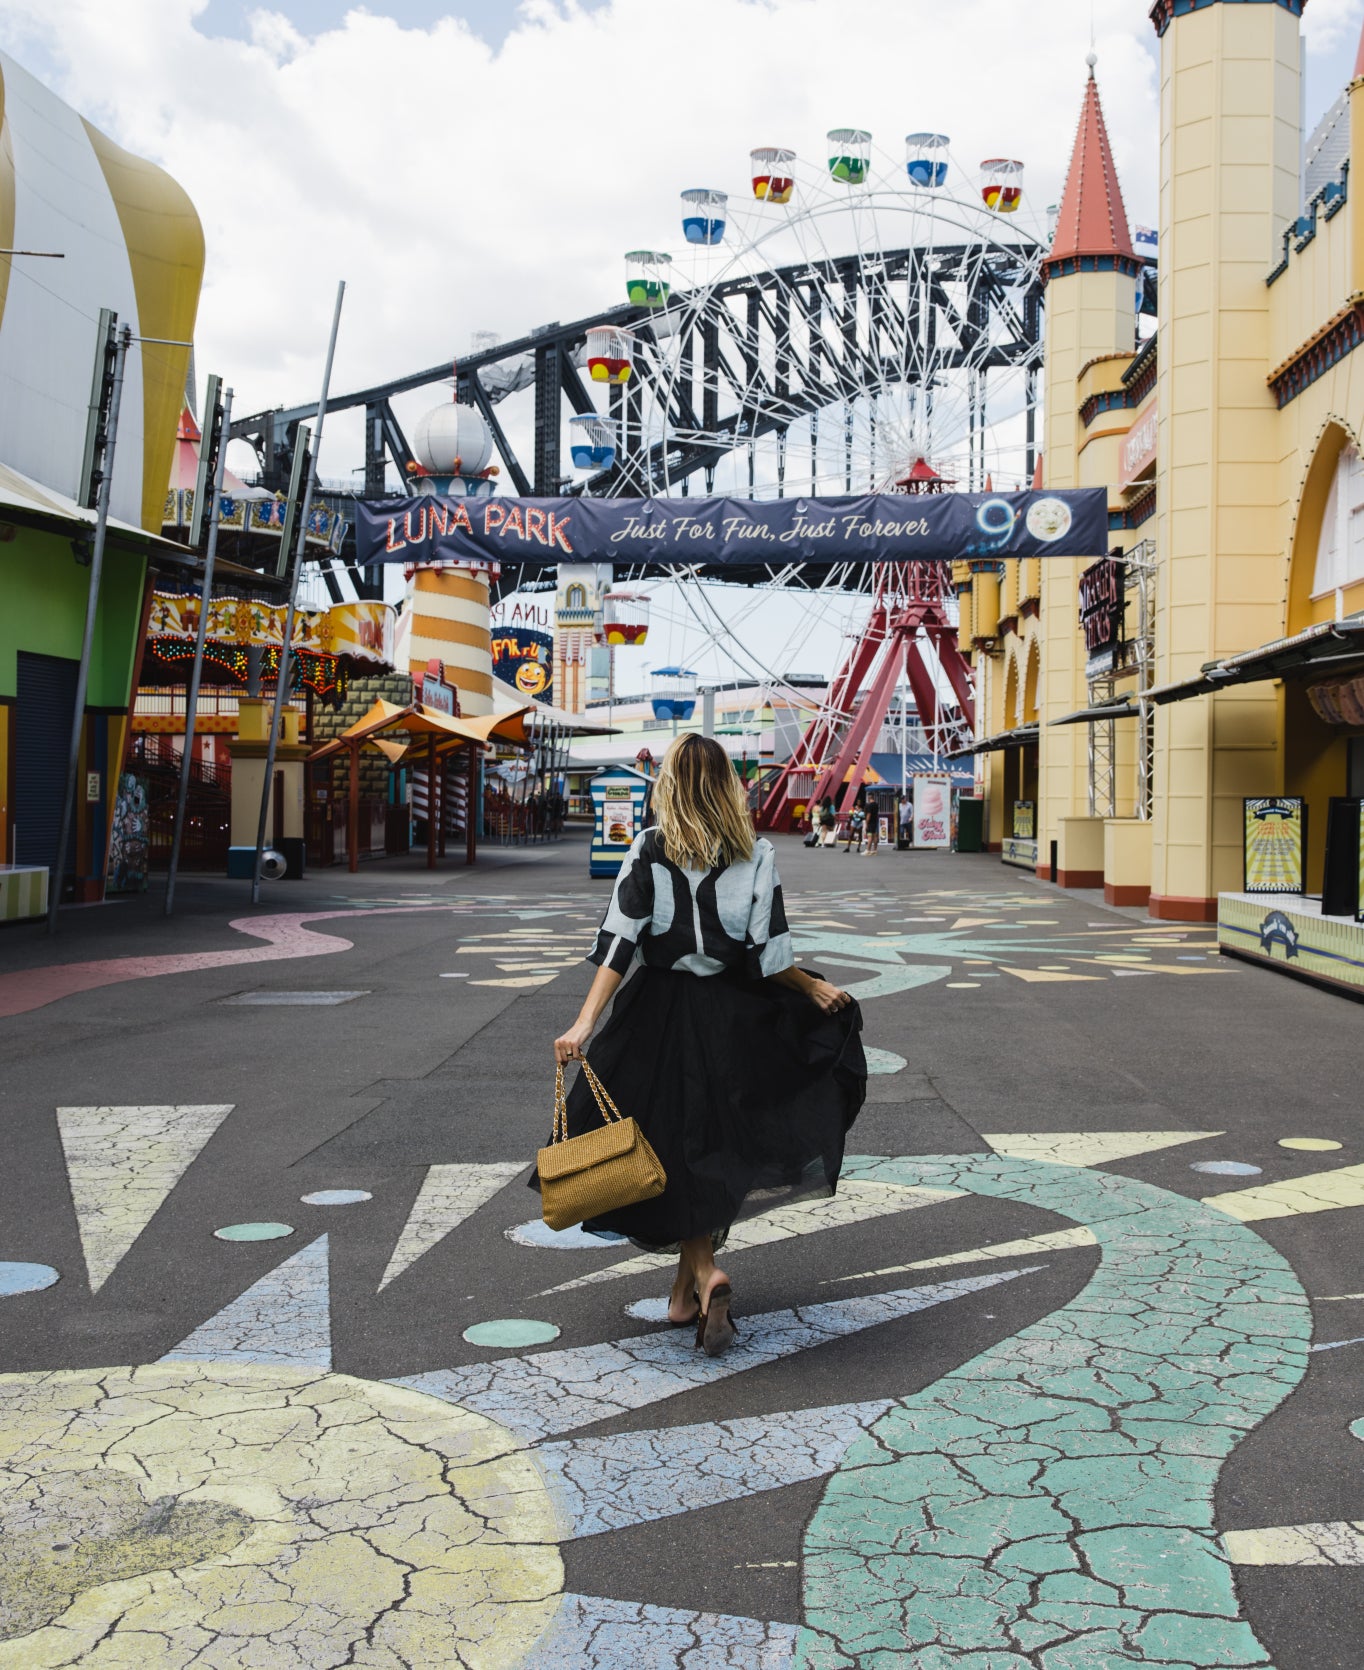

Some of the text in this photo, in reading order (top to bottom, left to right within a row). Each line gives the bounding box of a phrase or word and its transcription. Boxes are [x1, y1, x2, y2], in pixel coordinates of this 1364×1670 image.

[386, 503, 574, 553] LUNA PARK
[610, 515, 930, 543] Just For Fun, Just Forever
